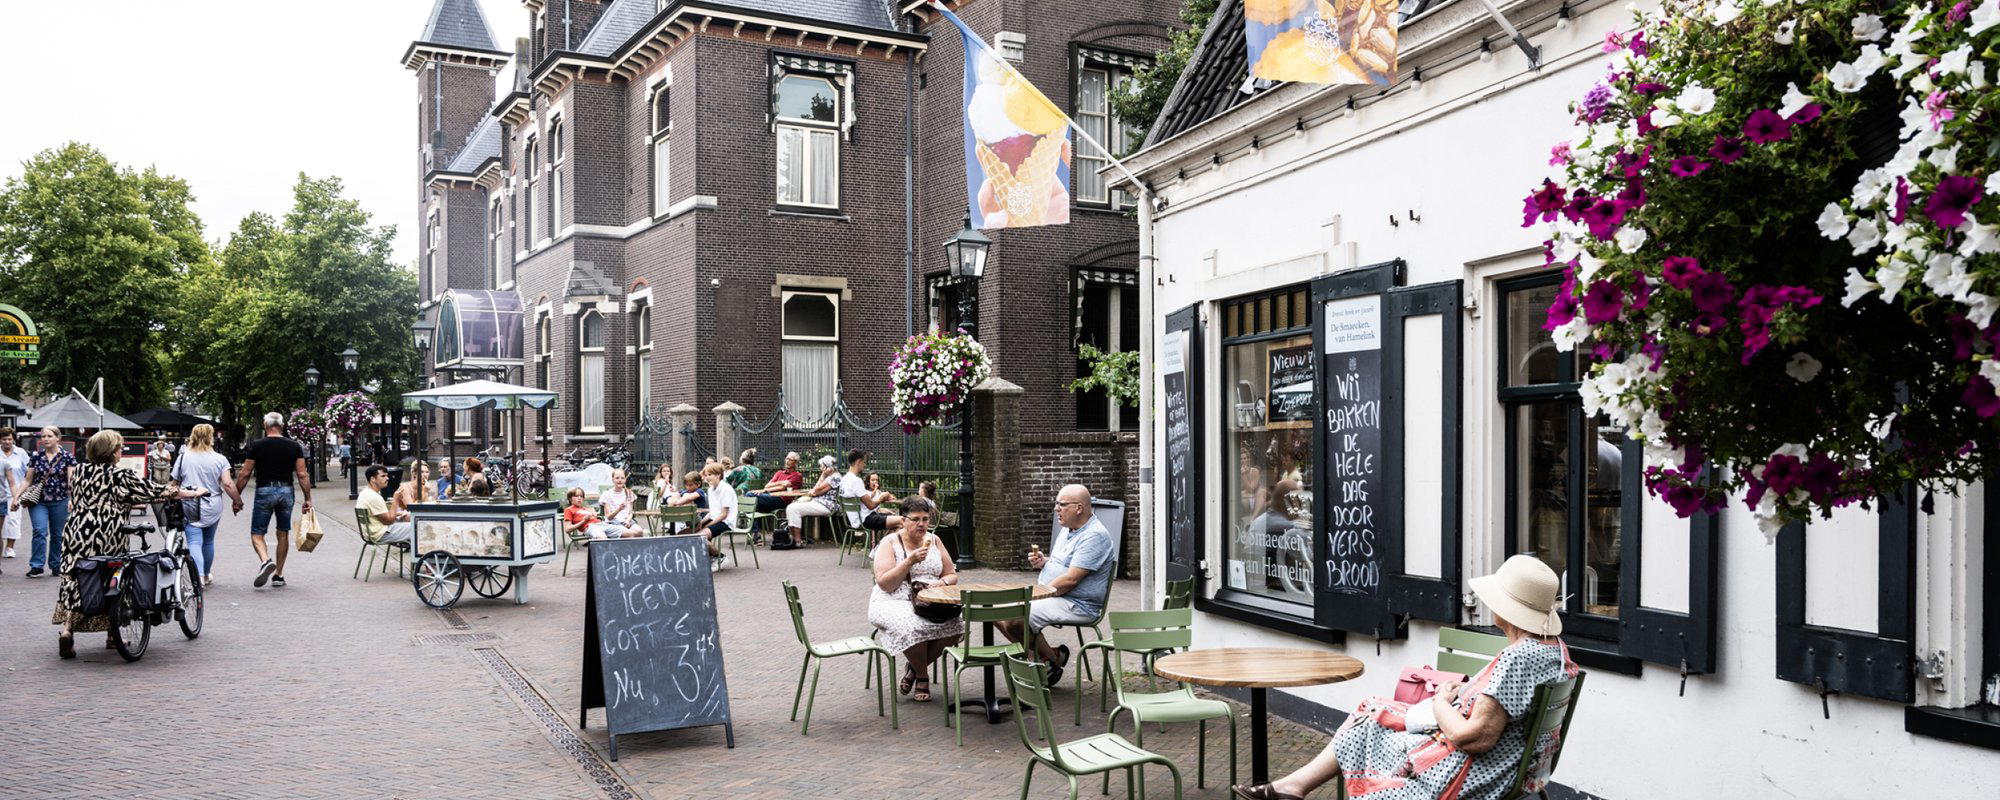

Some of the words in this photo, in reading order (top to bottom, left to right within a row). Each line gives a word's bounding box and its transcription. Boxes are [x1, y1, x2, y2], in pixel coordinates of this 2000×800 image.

[1330, 323, 1339, 333] De
[1334, 334, 1346, 343] van
[1327, 400, 1380, 433] BAKKEN
[1344, 433, 1360, 452] DE
[1335, 452, 1373, 478] HELE
[1343, 479, 1369, 503] DAG
[1333, 504, 1374, 528] DOOR
[1232, 521, 1246, 544] De
[1328, 528, 1375, 557] VERS
[602, 545, 698, 582] AMERICAN
[1326, 559, 1380, 588] BROOD
